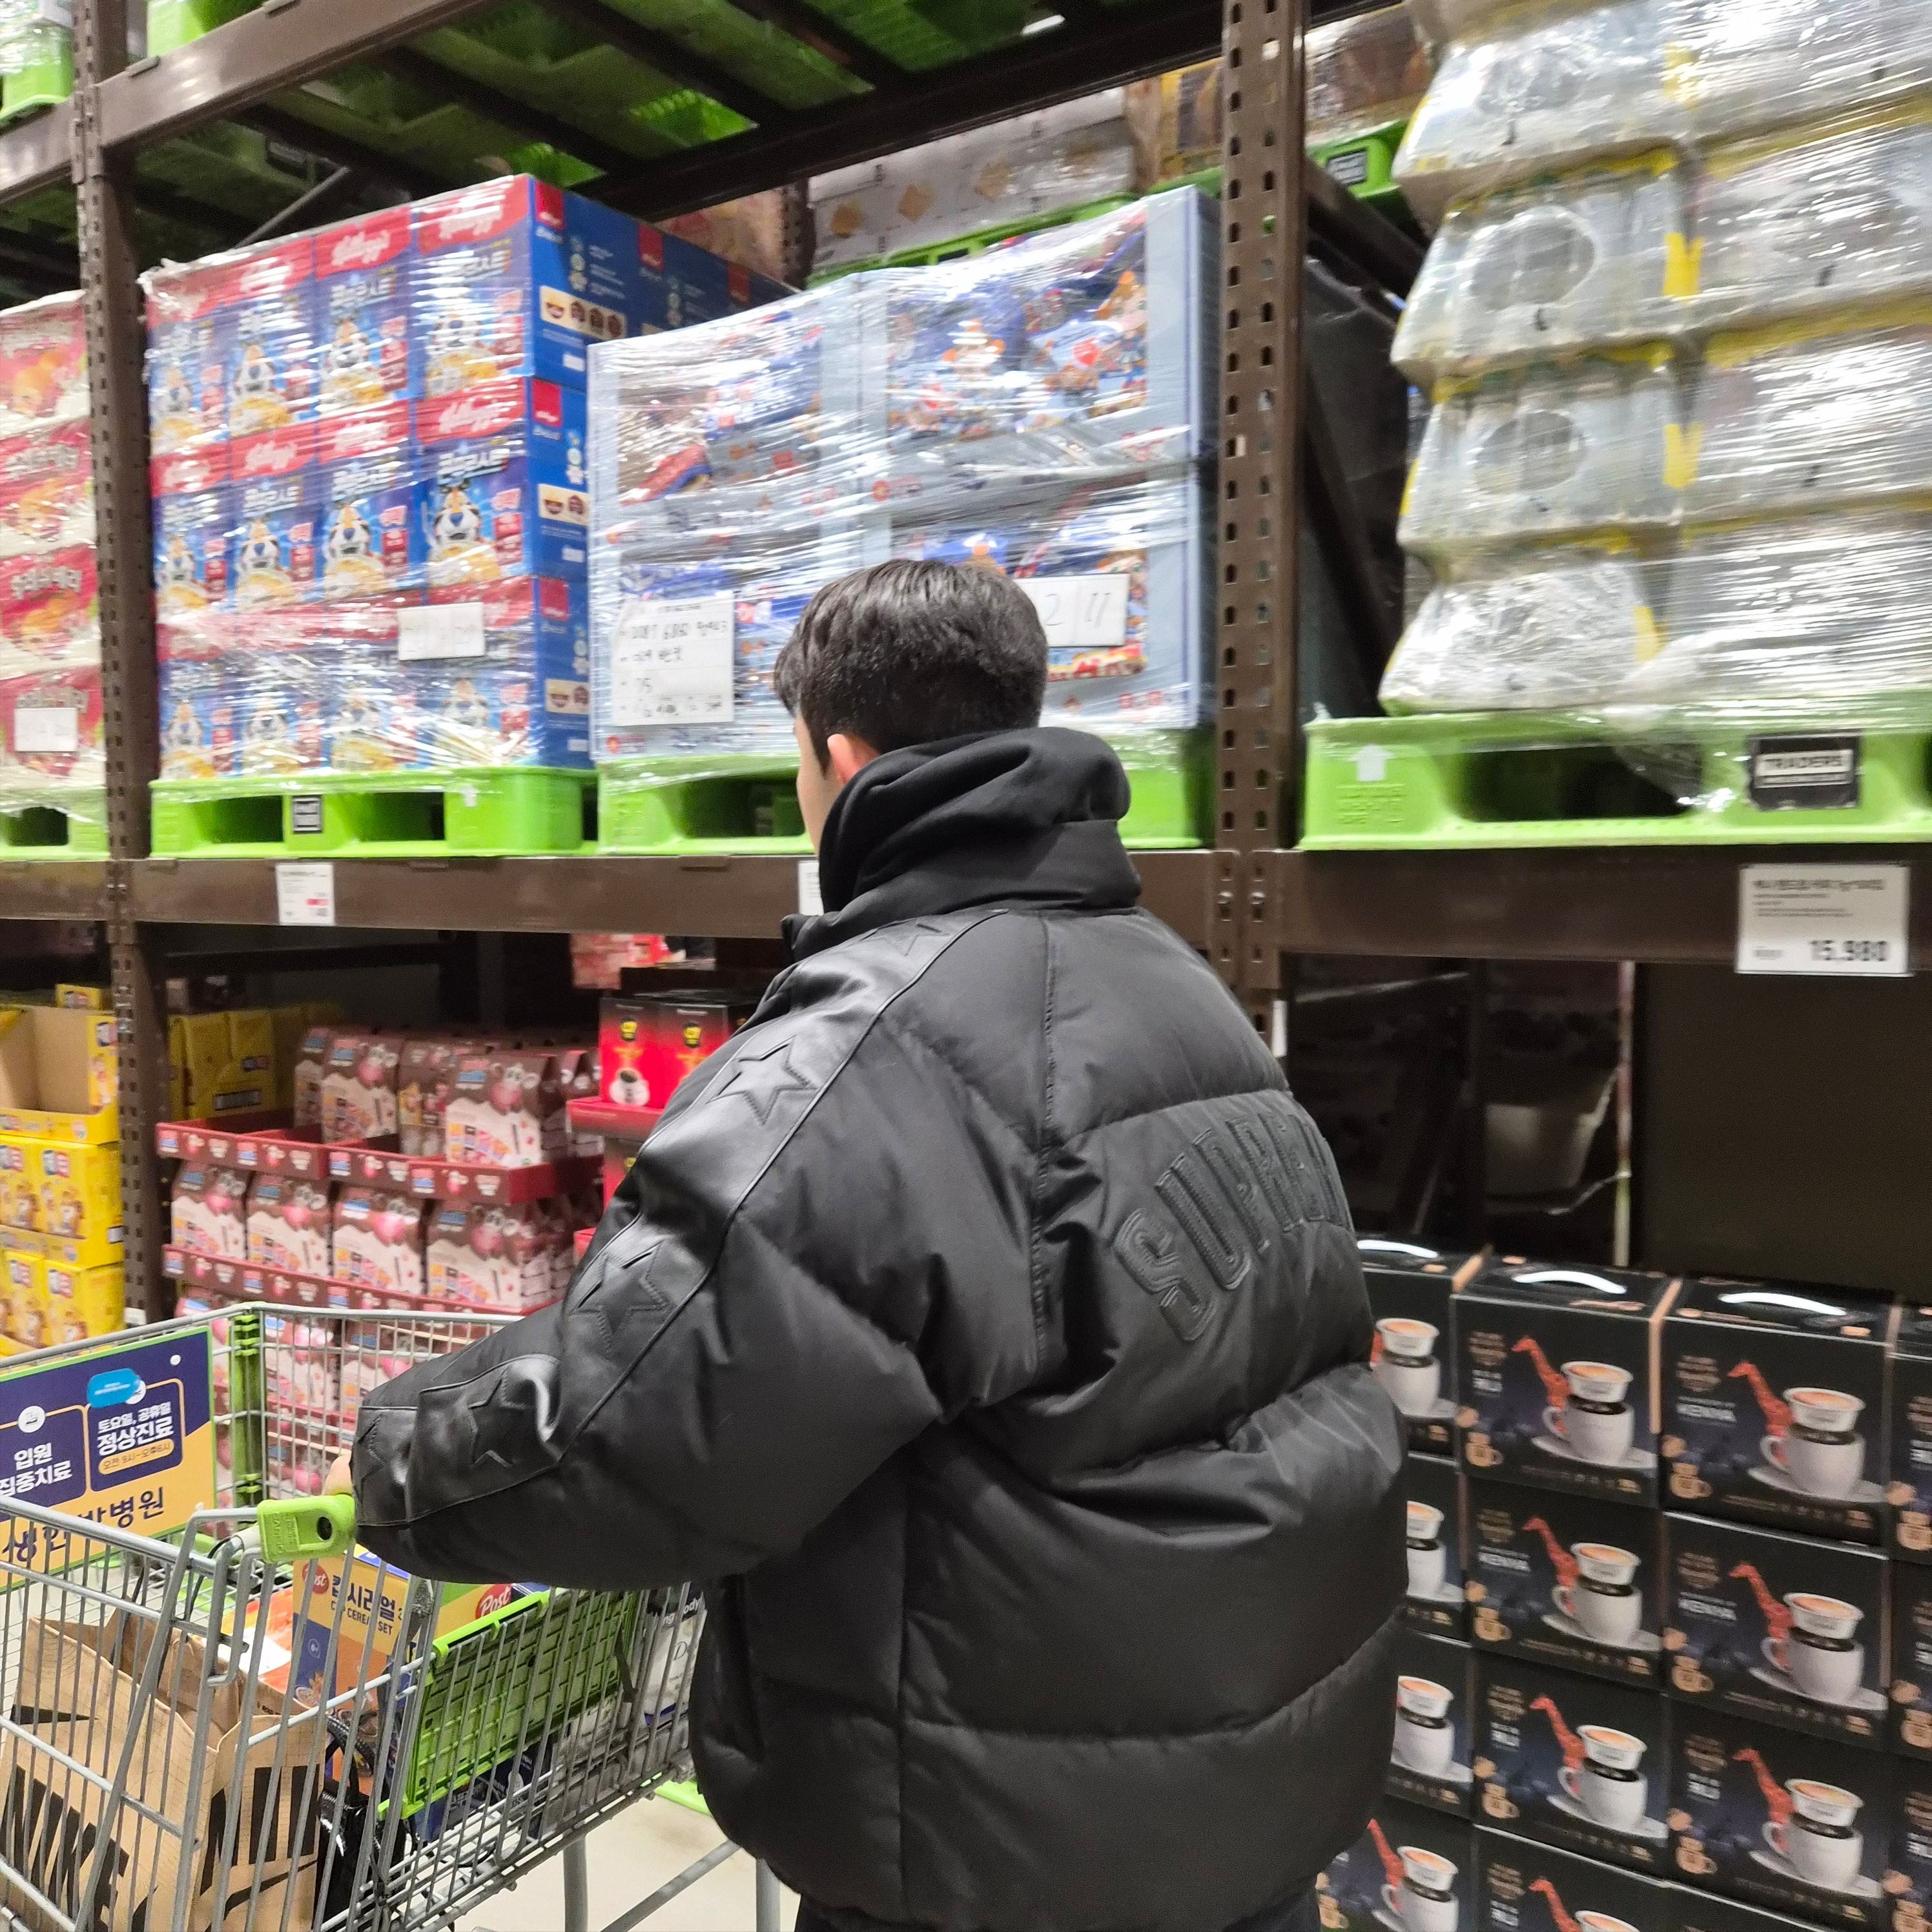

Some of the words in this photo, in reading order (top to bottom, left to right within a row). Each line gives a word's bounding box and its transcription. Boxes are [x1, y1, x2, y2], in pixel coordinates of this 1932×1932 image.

[98, 1412, 137, 1434] 토요일,
[138, 1401, 172, 1422] 공휴일
[97, 1416, 174, 1456] 정상진료
[14, 1443, 53, 1470] 입원
[480, 1585, 512, 1618] Post
[377, 1621, 393, 1636] SET
